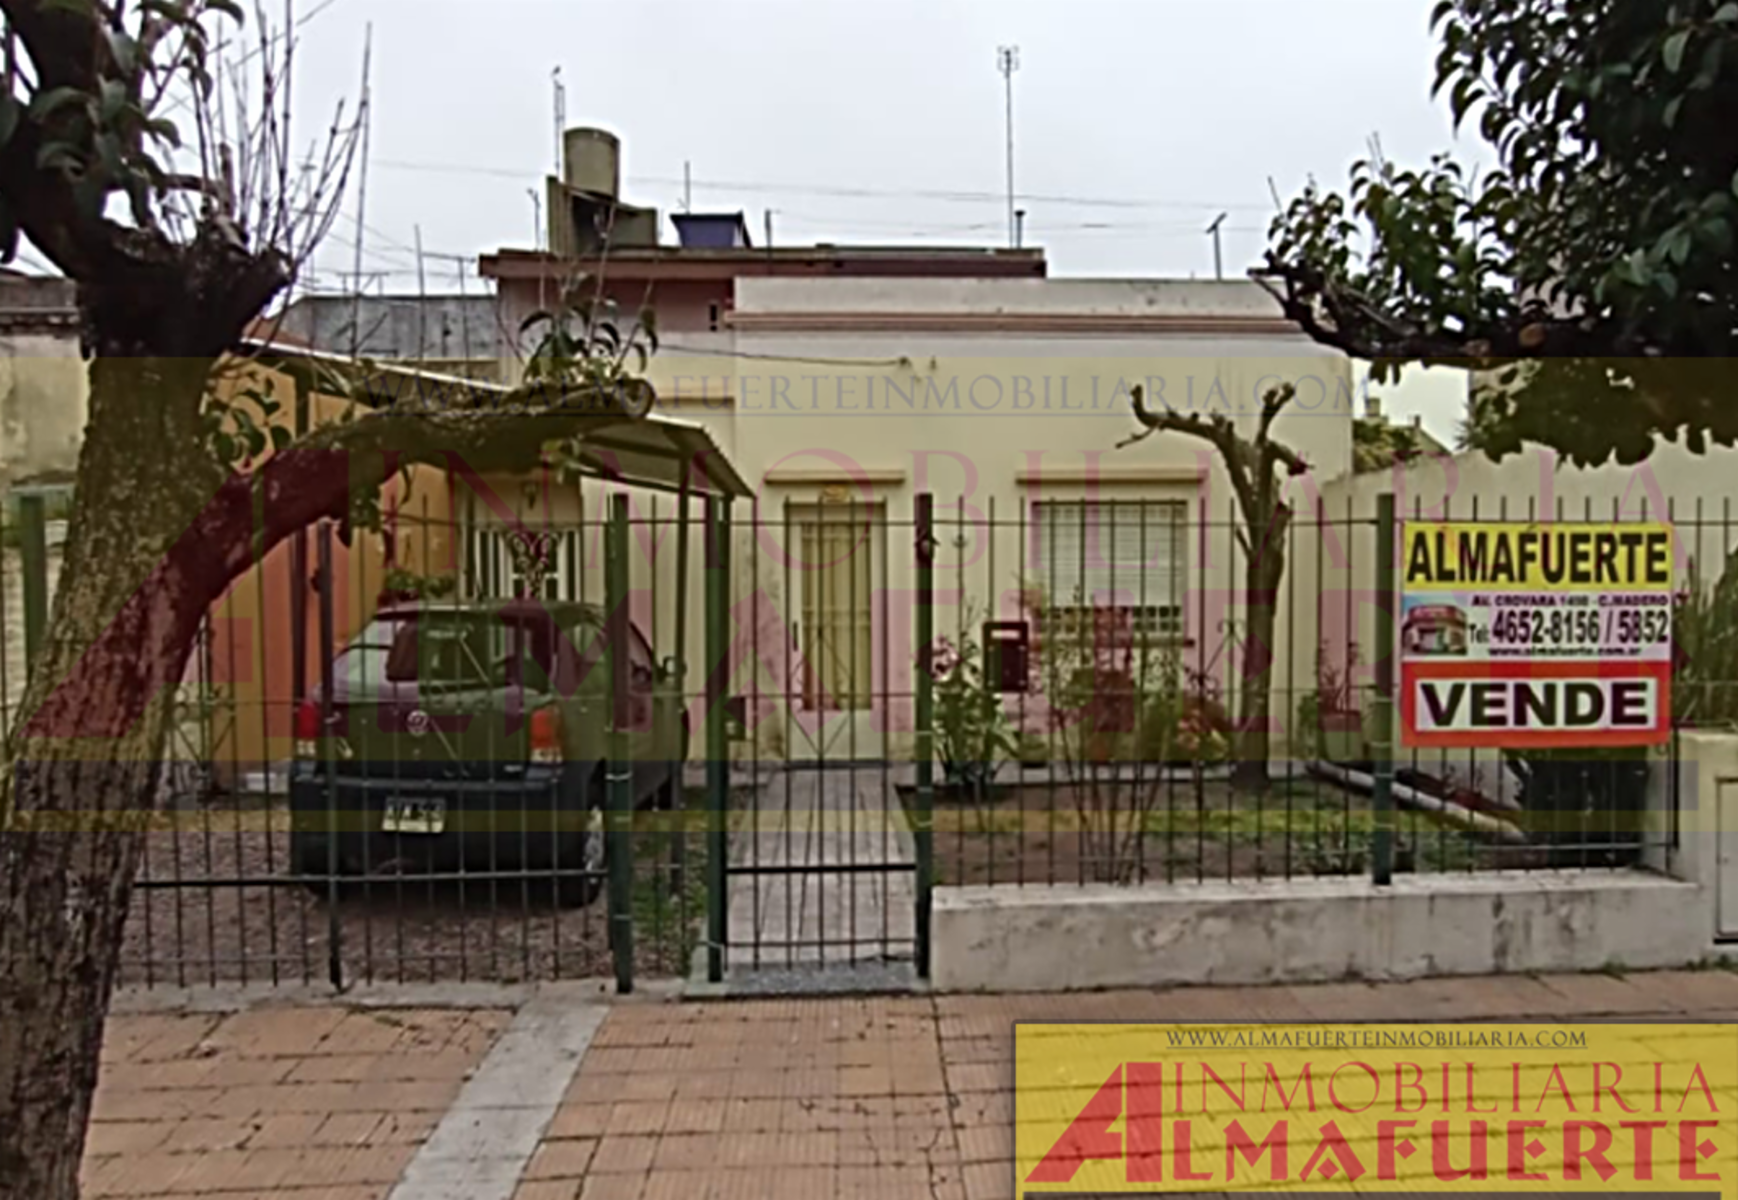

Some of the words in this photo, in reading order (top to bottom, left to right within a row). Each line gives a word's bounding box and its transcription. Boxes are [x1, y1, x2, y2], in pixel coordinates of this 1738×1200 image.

[1407, 531, 1669, 584] ALMAFUERTE
[1495, 595, 1556, 607] CROVARA
[1492, 610, 1599, 644] 4652-8156
[1617, 610, 1669, 644] 5852
[1420, 683, 1649, 727] VENDE
